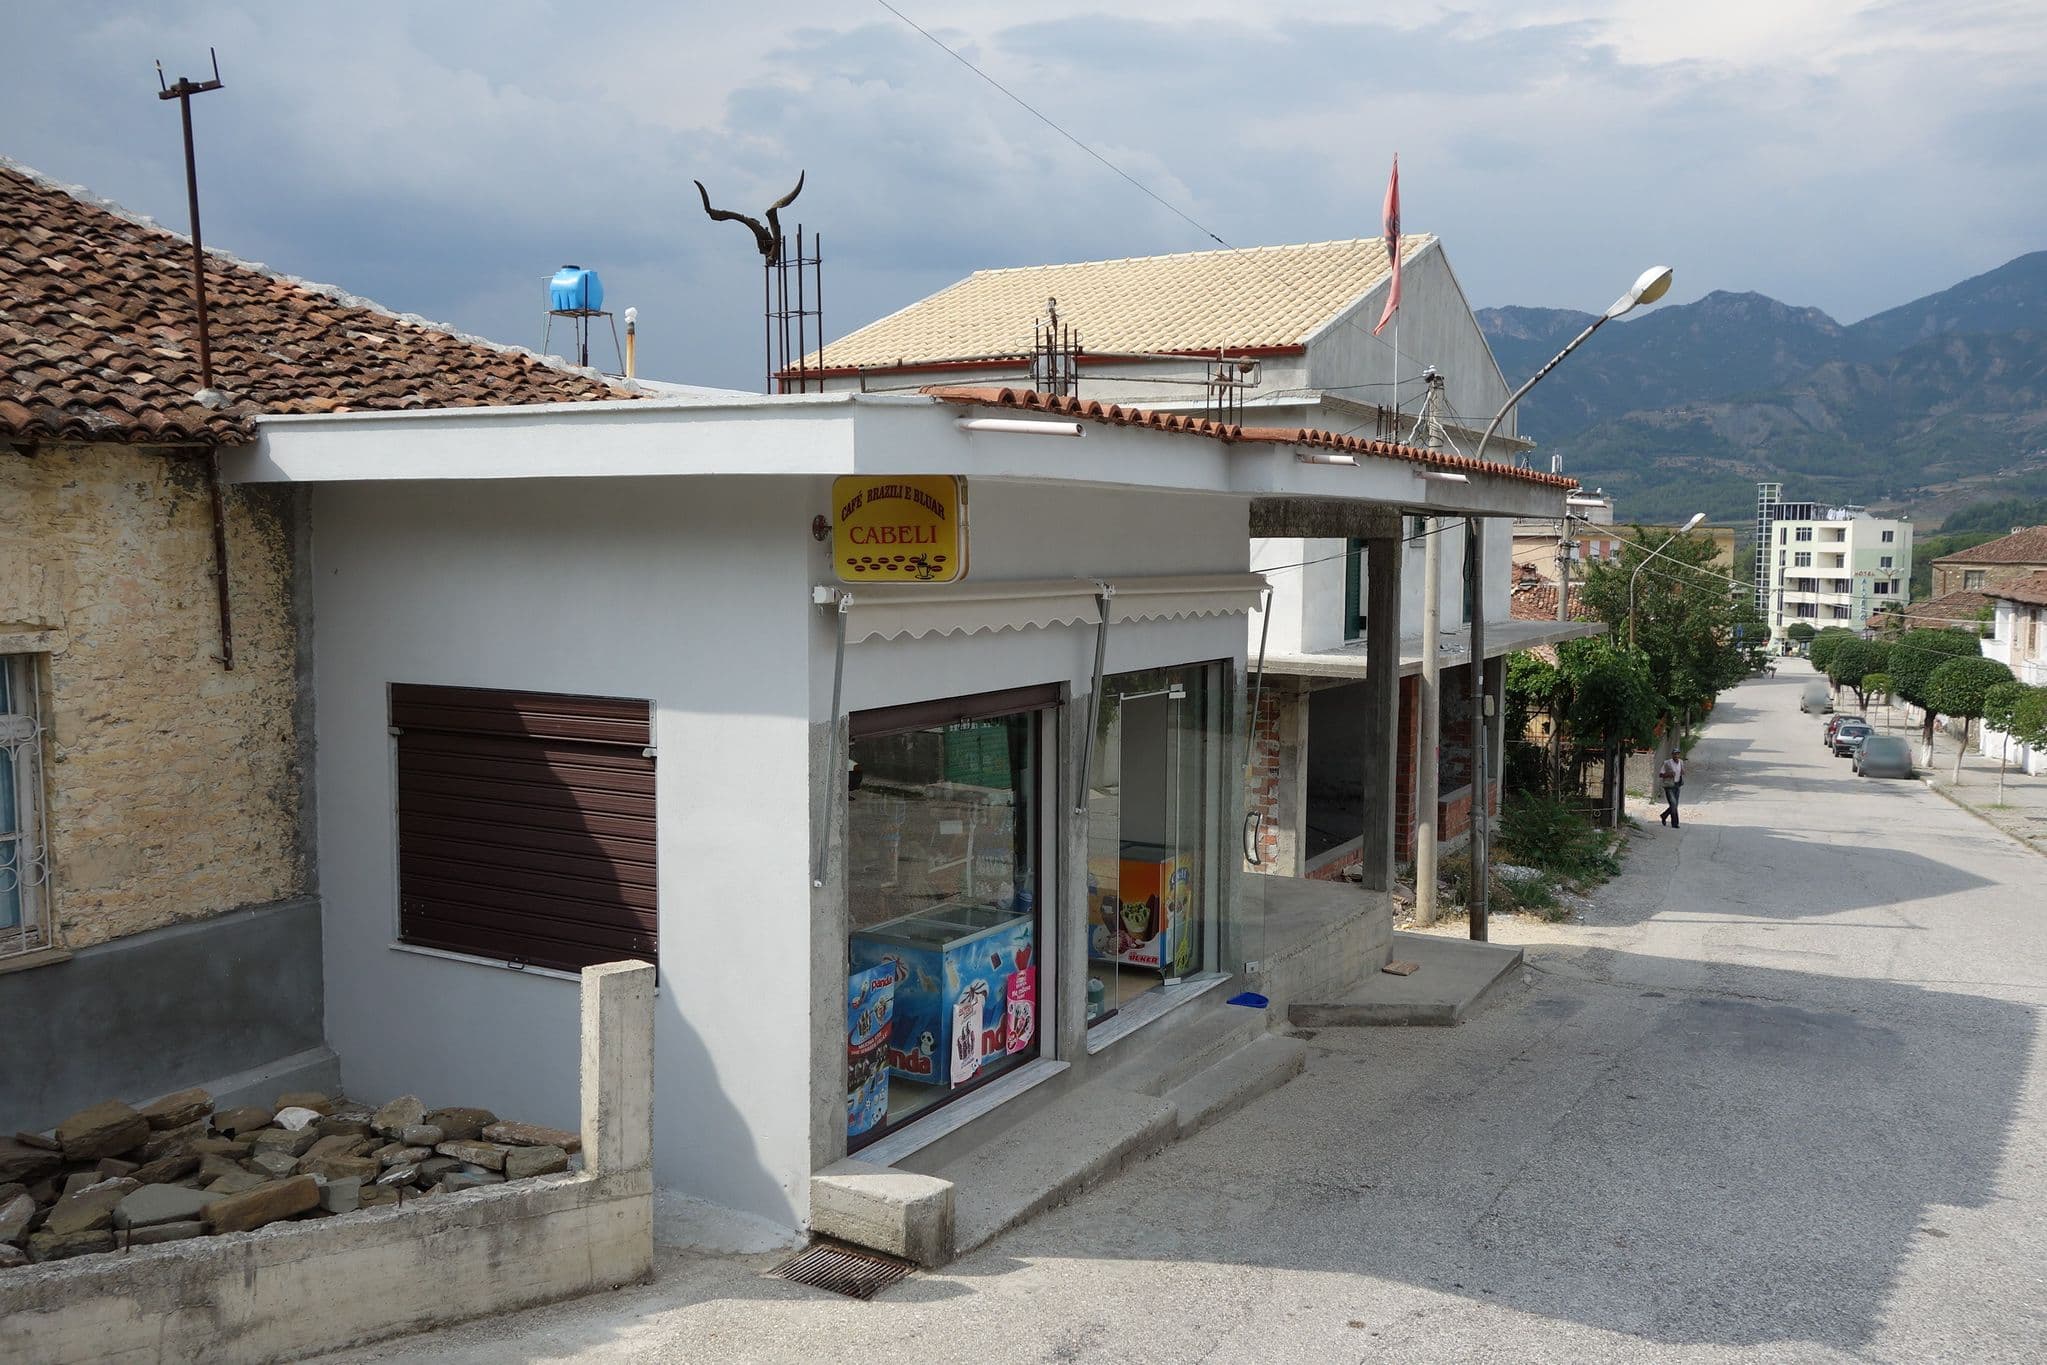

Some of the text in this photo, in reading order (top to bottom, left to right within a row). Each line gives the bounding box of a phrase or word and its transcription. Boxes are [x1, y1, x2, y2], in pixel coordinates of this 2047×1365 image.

[867, 485, 902, 503] BRAZILI
[905, 486, 912, 500] E
[849, 526, 937, 544] CABELI
